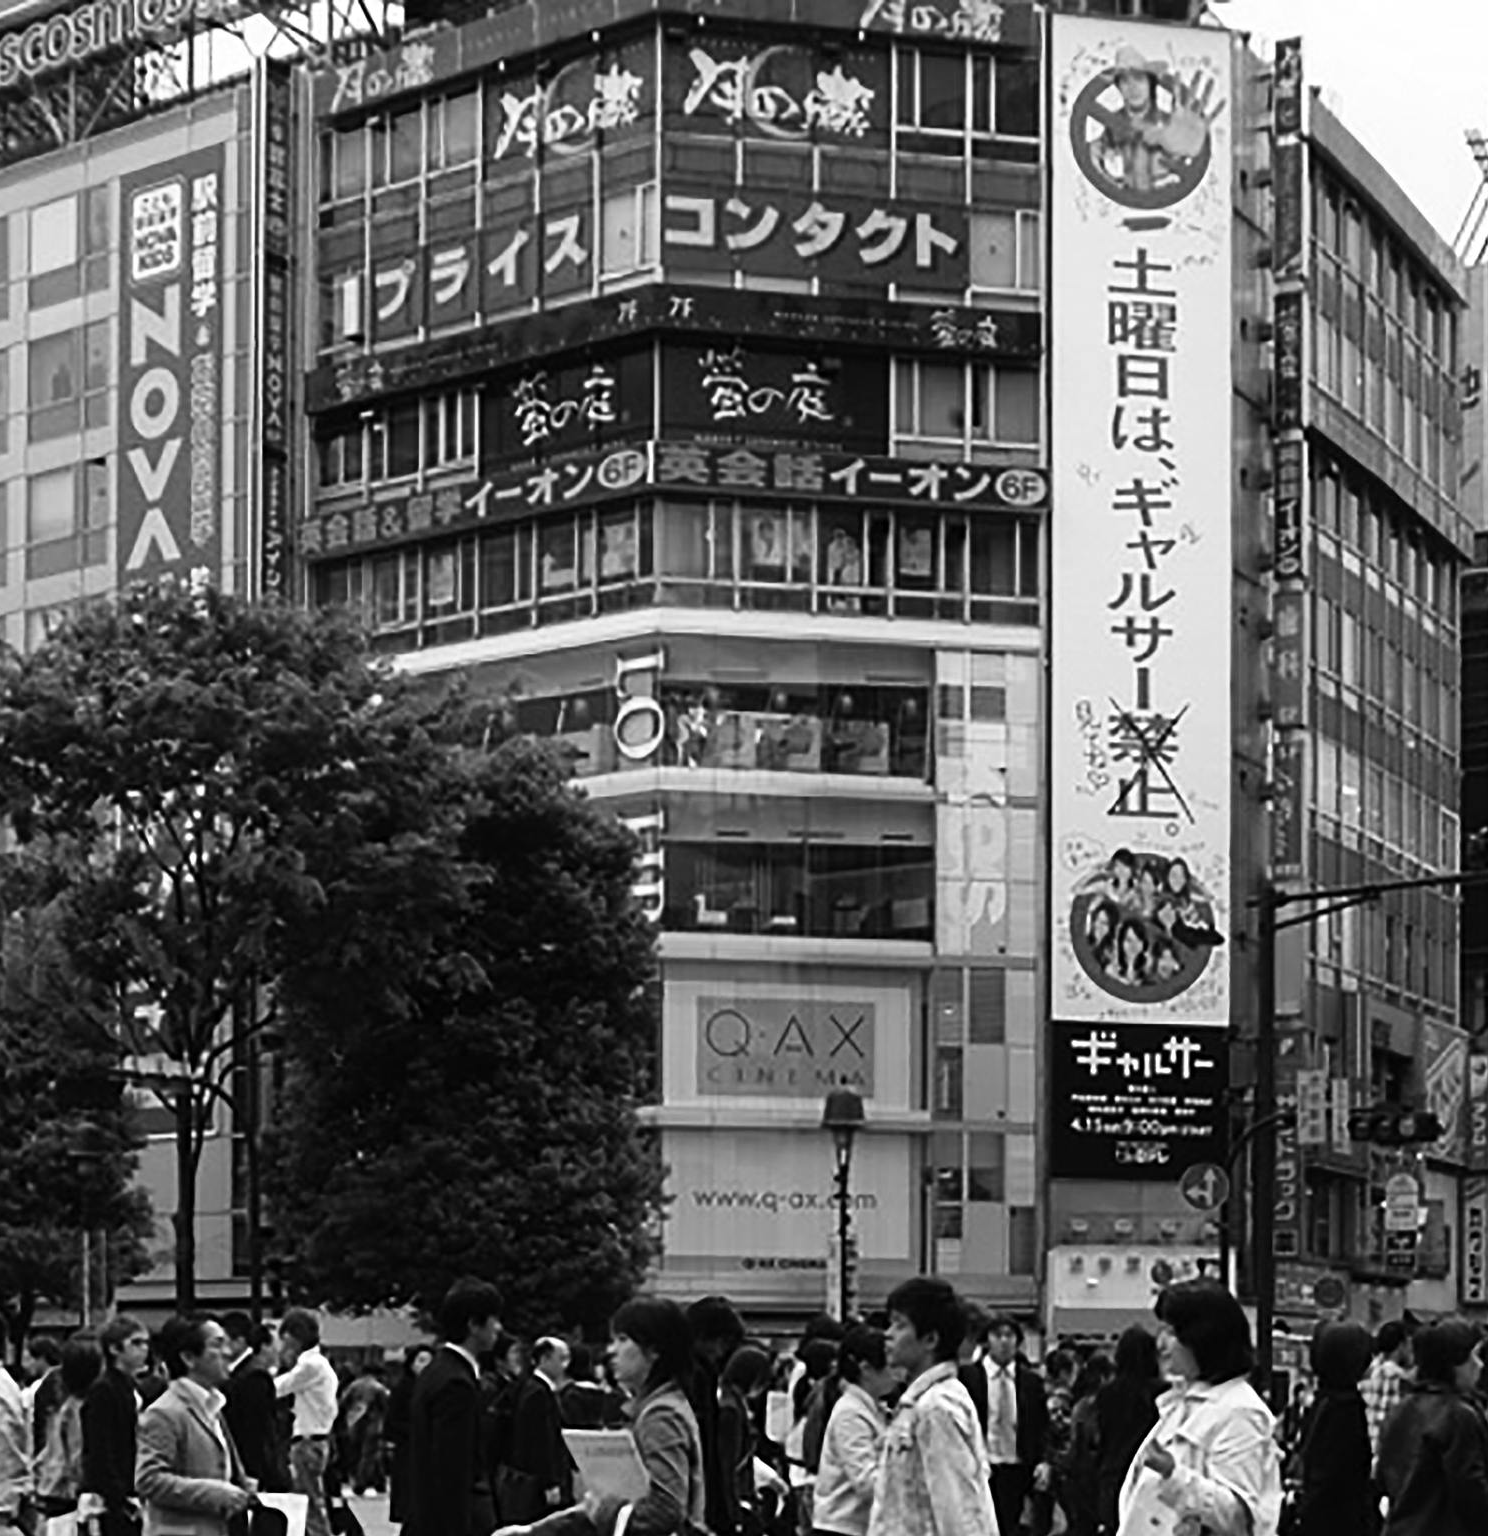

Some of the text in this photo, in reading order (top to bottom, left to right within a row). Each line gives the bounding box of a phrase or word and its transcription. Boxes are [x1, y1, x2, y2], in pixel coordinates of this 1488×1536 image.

[376, 215, 586, 320] プライス
[665, 195, 959, 267] コンタクト
[129, 284, 183, 571] NOVA
[693, 1191, 877, 1213] www.q-ax.cm
